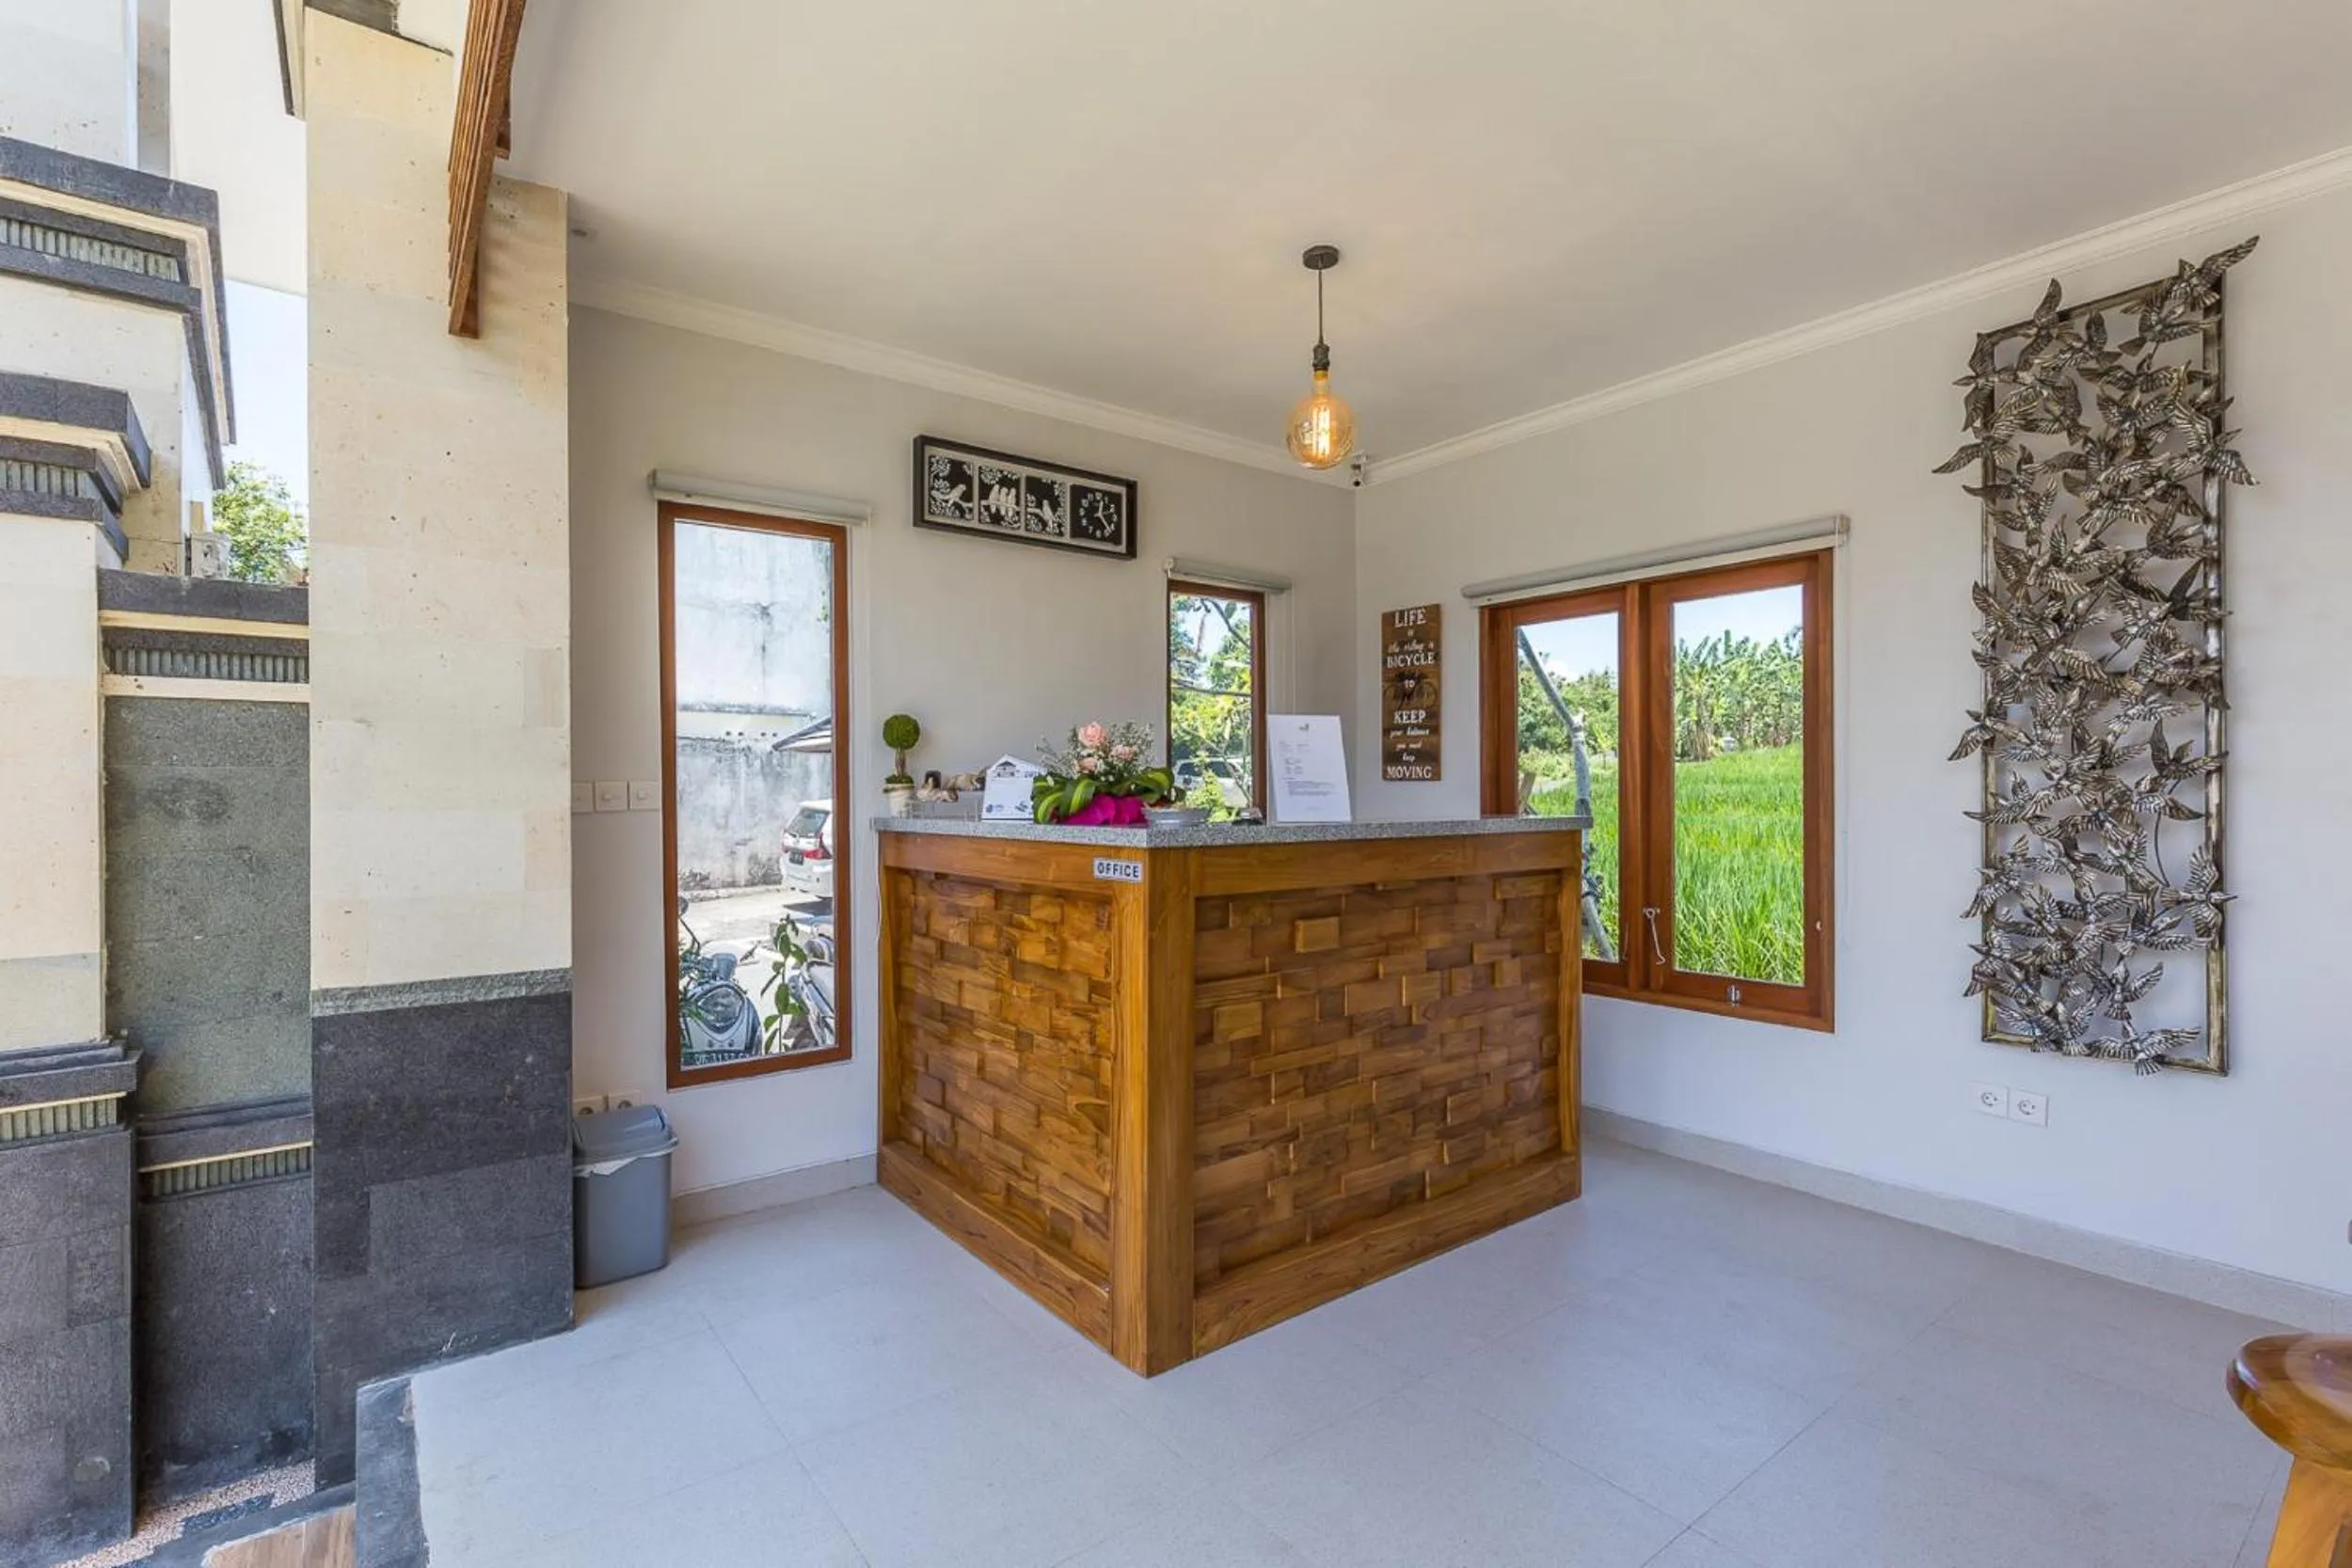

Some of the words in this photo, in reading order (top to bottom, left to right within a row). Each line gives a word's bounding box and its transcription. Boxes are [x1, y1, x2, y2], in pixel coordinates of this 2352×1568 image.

[1394, 609, 1426, 627] LIFE
[1387, 652, 1435, 669] BICYCLE
[1393, 709, 1426, 724] KEEP
[1387, 766, 1433, 779] MOVING
[1097, 862, 1139, 879] OFFICE
